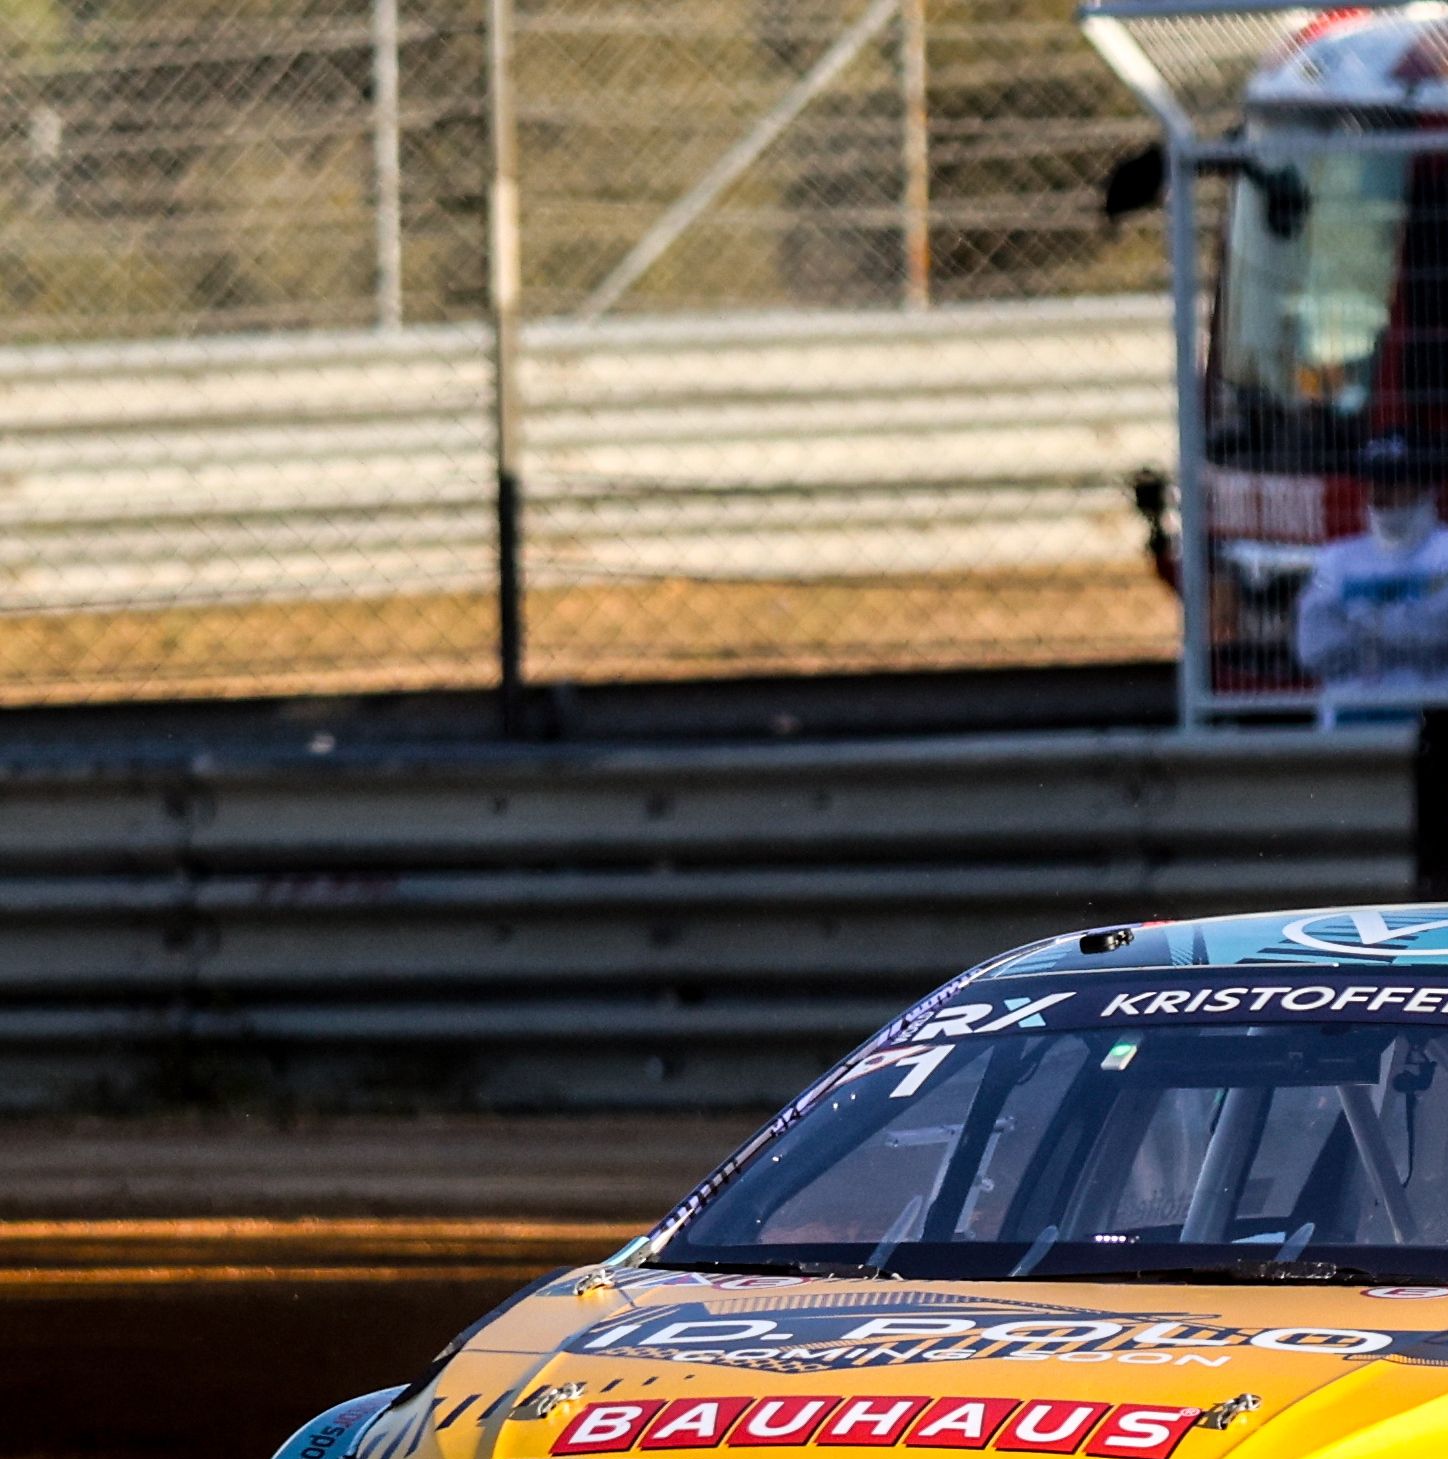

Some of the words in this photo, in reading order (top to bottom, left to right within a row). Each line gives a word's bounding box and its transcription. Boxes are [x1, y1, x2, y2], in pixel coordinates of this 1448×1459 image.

[911, 992, 1077, 1041] RX
[840, 1317, 1393, 1354] POLO
[672, 1348, 978, 1363] COMING
[1003, 1350, 1232, 1368] SOON
[568, 1401, 1186, 1448] BAUHAUS
